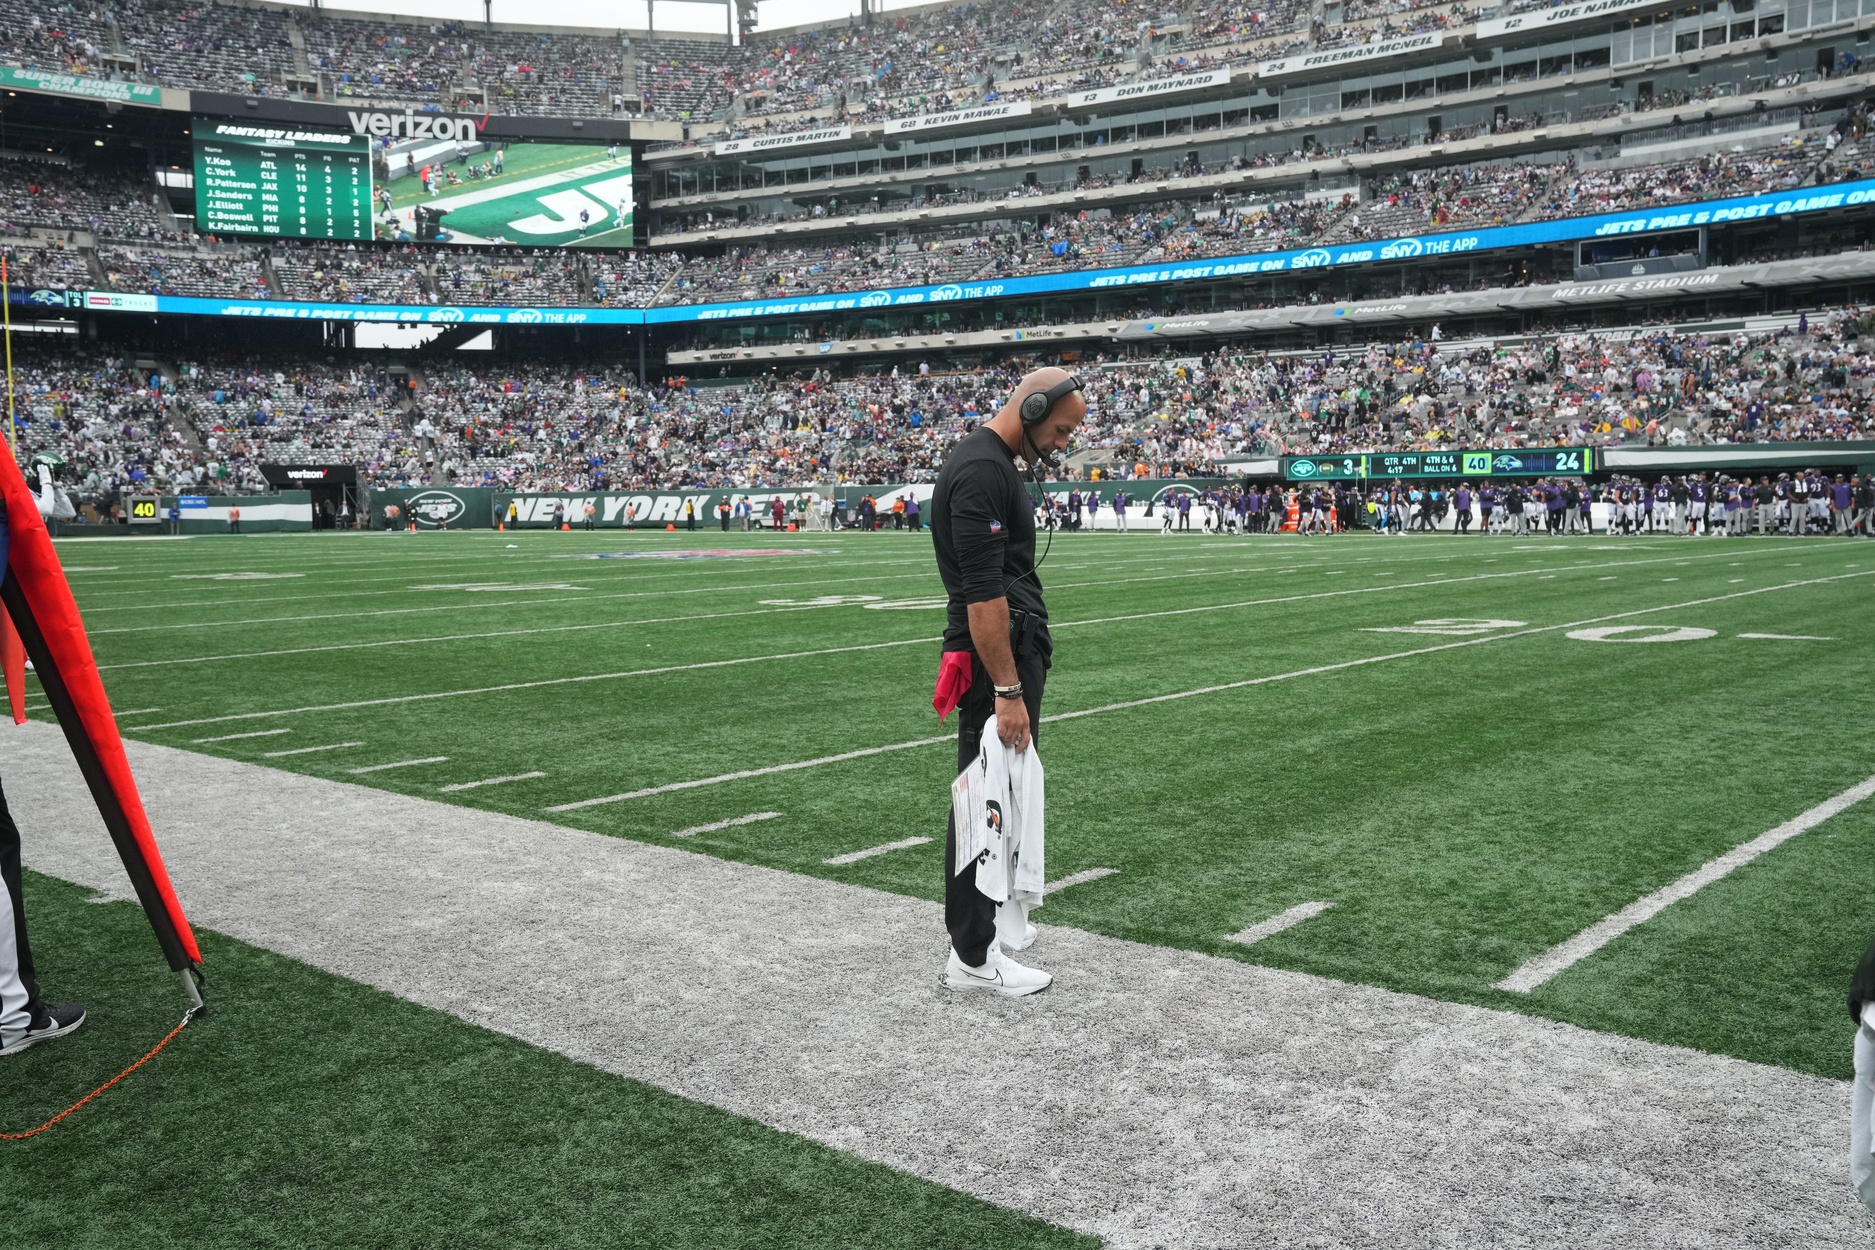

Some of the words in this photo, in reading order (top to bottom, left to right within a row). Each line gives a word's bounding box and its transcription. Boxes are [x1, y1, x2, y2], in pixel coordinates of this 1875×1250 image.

[1504, 19, 1522, 29] 12
[1547, 9, 1580, 21] JOE
[1583, 0, 1643, 14] NAMA
[1266, 63, 1285, 72] 24
[1303, 47, 1375, 66] FREEMAN
[1376, 36, 1434, 53] MCNEIL
[13, 69, 76, 85] SUPER
[78, 78, 130, 92] BOWL
[132, 85, 154, 96] III
[38, 80, 132, 99] CHAMPIONS
[1083, 94, 1097, 102] 13
[1116, 86, 1146, 97] DON
[1147, 76, 1213, 92] MAYNARD
[347, 108, 476, 140] verizon
[900, 120, 916, 129] 68
[924, 112, 960, 126] KEVIN
[963, 106, 1011, 121] MAWAE
[216, 125, 285, 139] FANTASY
[284, 131, 351, 144] LEADERS
[265, 138, 295, 146] KICKING
[724, 143, 739, 151] 28
[753, 136, 794, 147] CURTIS
[795, 130, 842, 144] MARTIN
[205, 157, 231, 166] Y.Koo
[260, 161, 277, 170] ATL
[295, 164, 306, 172] 14
[206, 168, 236, 177] C.York
[261, 172, 277, 180] CLE
[296, 174, 306, 182] 11
[206, 178, 257, 189] R.Patterson
[261, 183, 278, 191] JAX
[296, 185, 307, 193] 10
[326, 186, 332, 194] 3
[207, 189, 253, 200] J.Sanders
[262, 193, 278, 202] MIA
[326, 197, 332, 205] 2
[207, 201, 243, 211] J.Elliott
[262, 204, 279, 212] PHI
[353, 209, 359, 217] 5
[1595, 219, 1647, 235] JETS
[1647, 213, 1692, 229] PRE
[1693, 211, 1710, 224] &
[1712, 203, 1773, 222] POST
[1774, 193, 1845, 213] GAME
[1846, 189, 1875, 204] ON
[207, 211, 253, 221] C.Boswell
[263, 215, 279, 223] PIT
[300, 217, 306, 225] 8
[327, 218, 333, 226] 2
[208, 221, 258, 233] K.Fairbairn
[263, 225, 279, 233] HOU
[354, 230, 360, 238] 2
[1090, 275, 1127, 287] JETS
[1127, 271, 1159, 284] PRE
[1159, 270, 1172, 281] &
[1171, 266, 1212, 279] POST
[1213, 262, 1259, 275] GAME
[1261, 259, 1285, 271] ON
[1291, 248, 1331, 268] SNY
[1336, 250, 1373, 263] AND
[1380, 238, 1423, 259] SNY
[1425, 240, 1450, 254] THE
[1452, 237, 1478, 252] APP
[1552, 281, 1630, 298] METLIFE
[1632, 274, 1719, 291] STADIUM
[73, 299, 80, 307] 3
[697, 309, 727, 319] JETS
[728, 307, 754, 317] PRE
[754, 306, 764, 315] &
[764, 304, 798, 314] POST
[798, 301, 836, 311] GAME
[836, 299, 855, 309] ON
[859, 291, 891, 308] SNY
[896, 293, 924, 304] AND
[929, 284, 962, 301] SNY
[964, 286, 983, 298] THE
[985, 285, 1003, 297] APP
[1354, 303, 1407, 314] MetLife
[221, 306, 262, 316] JETS
[263, 307, 296, 317] PRE
[298, 309, 310, 318] &
[311, 309, 353, 320] POST
[354, 311, 399, 321] GAME
[400, 312, 422, 321] ON
[428, 308, 464, 322] SNY
[469, 313, 501, 322] AND
[507, 308, 542, 323] SNY
[544, 313, 564, 323] THE
[566, 313, 586, 323] APP
[1162, 319, 1209, 329] MetLife
[1026, 329, 1052, 338] MetLife
[709, 351, 736, 360] verizon
[820, 344, 831, 353] SAP
[1343, 459, 1353, 475] 3
[1384, 458, 1399, 466] QTR
[1402, 457, 1416, 465] 4TH
[1426, 456, 1440, 464] 4TH
[1441, 456, 1448, 464] &
[1449, 455, 1454, 463] 6
[1468, 457, 1486, 470] 40
[1556, 452, 1579, 470] 24
[287, 469, 323, 478] verizon
[1387, 466, 1403, 474] 4:17
[1441, 464, 1450, 472] ON
[1452, 464, 1457, 472] 6
[1658, 489, 1668, 497] 63
[1697, 488, 1703, 497] 5
[1810, 483, 1822, 492] 93
[134, 503, 155, 517] 40
[504, 496, 597, 522] NEW
[602, 495, 711, 522] YORK
